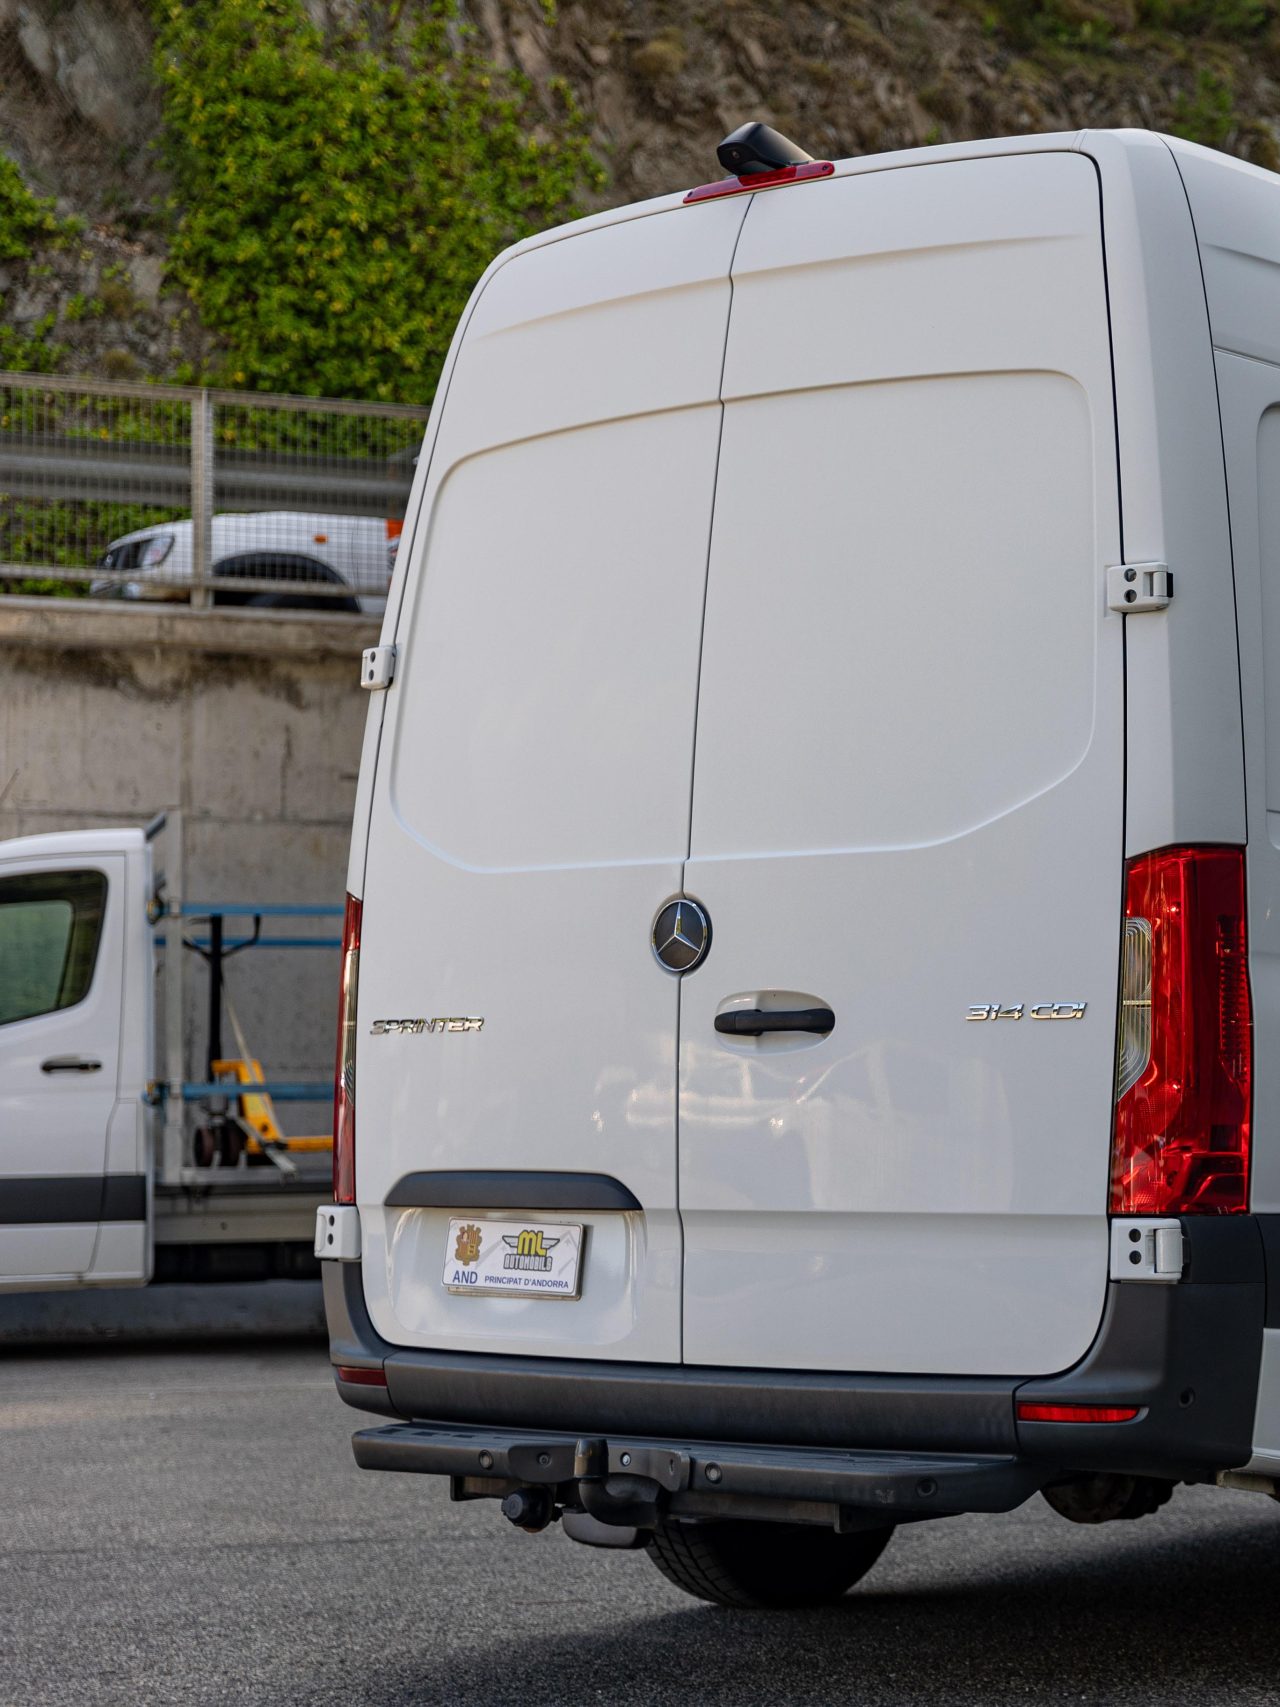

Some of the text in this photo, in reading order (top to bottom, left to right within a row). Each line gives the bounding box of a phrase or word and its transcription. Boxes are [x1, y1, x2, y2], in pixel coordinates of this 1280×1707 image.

[965, 1002, 1087, 1020] 314 CDI
[370, 1017, 484, 1035] SPRINTER
[517, 1230, 547, 1256] ML
[452, 1270, 569, 1289] AND PRINCIPAT D'ANDORRA
